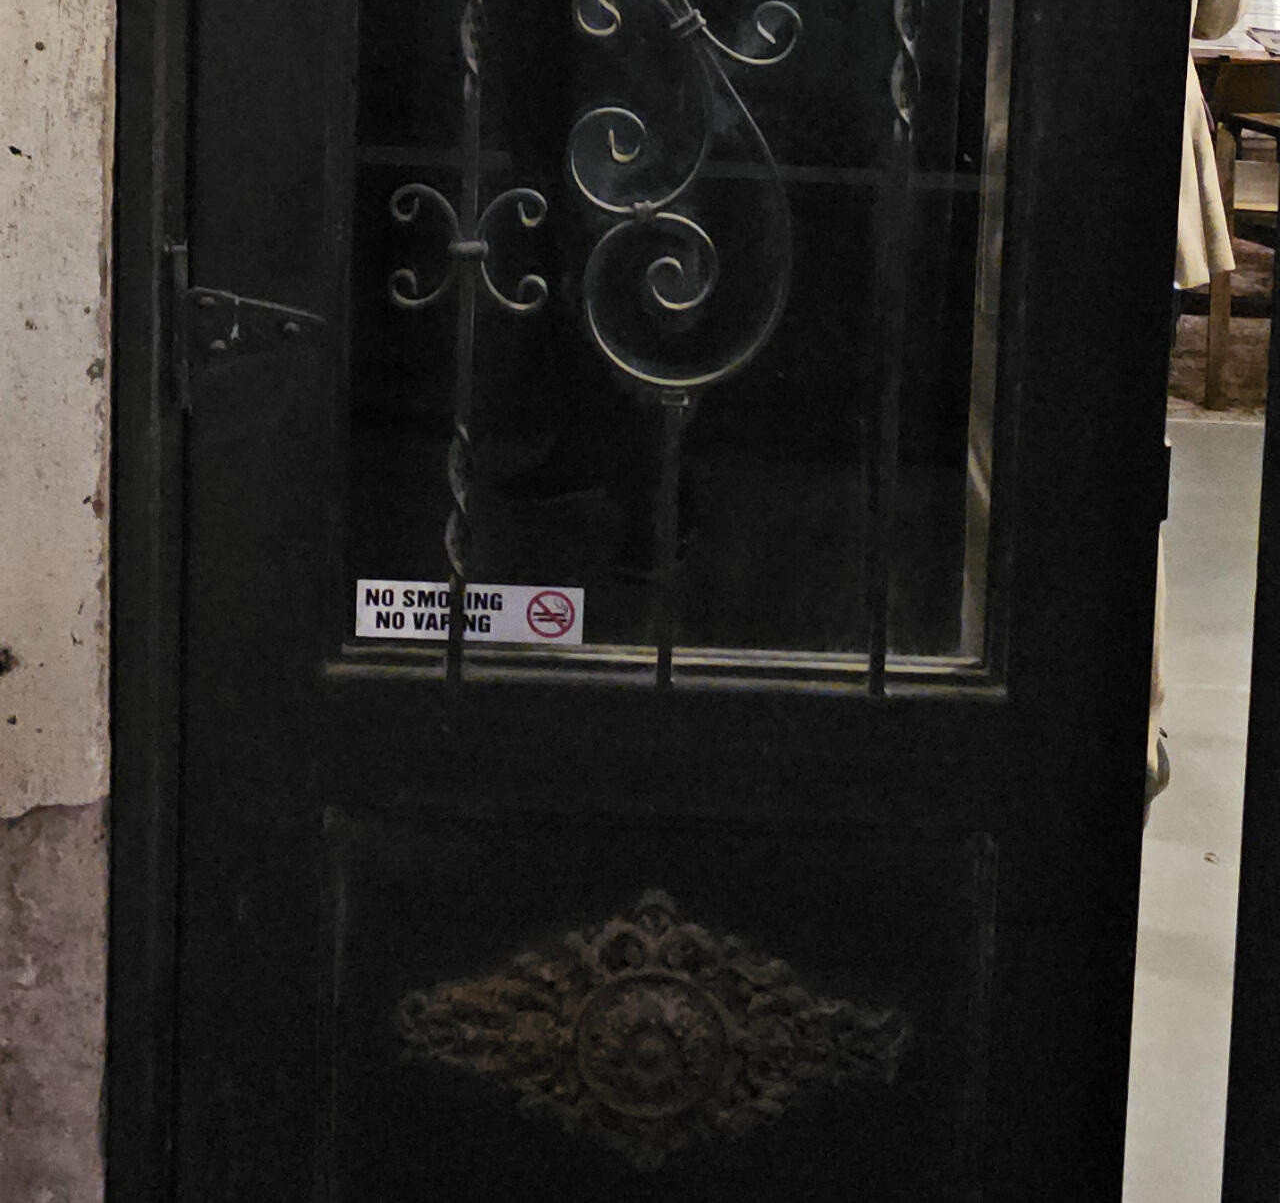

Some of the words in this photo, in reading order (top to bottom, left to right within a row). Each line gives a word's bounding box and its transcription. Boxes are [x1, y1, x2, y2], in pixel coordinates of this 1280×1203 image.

[365, 588, 395, 608] NO
[402, 589, 503, 612] SMOING
[375, 610, 406, 630] NO
[412, 611, 492, 634] VAPNG
